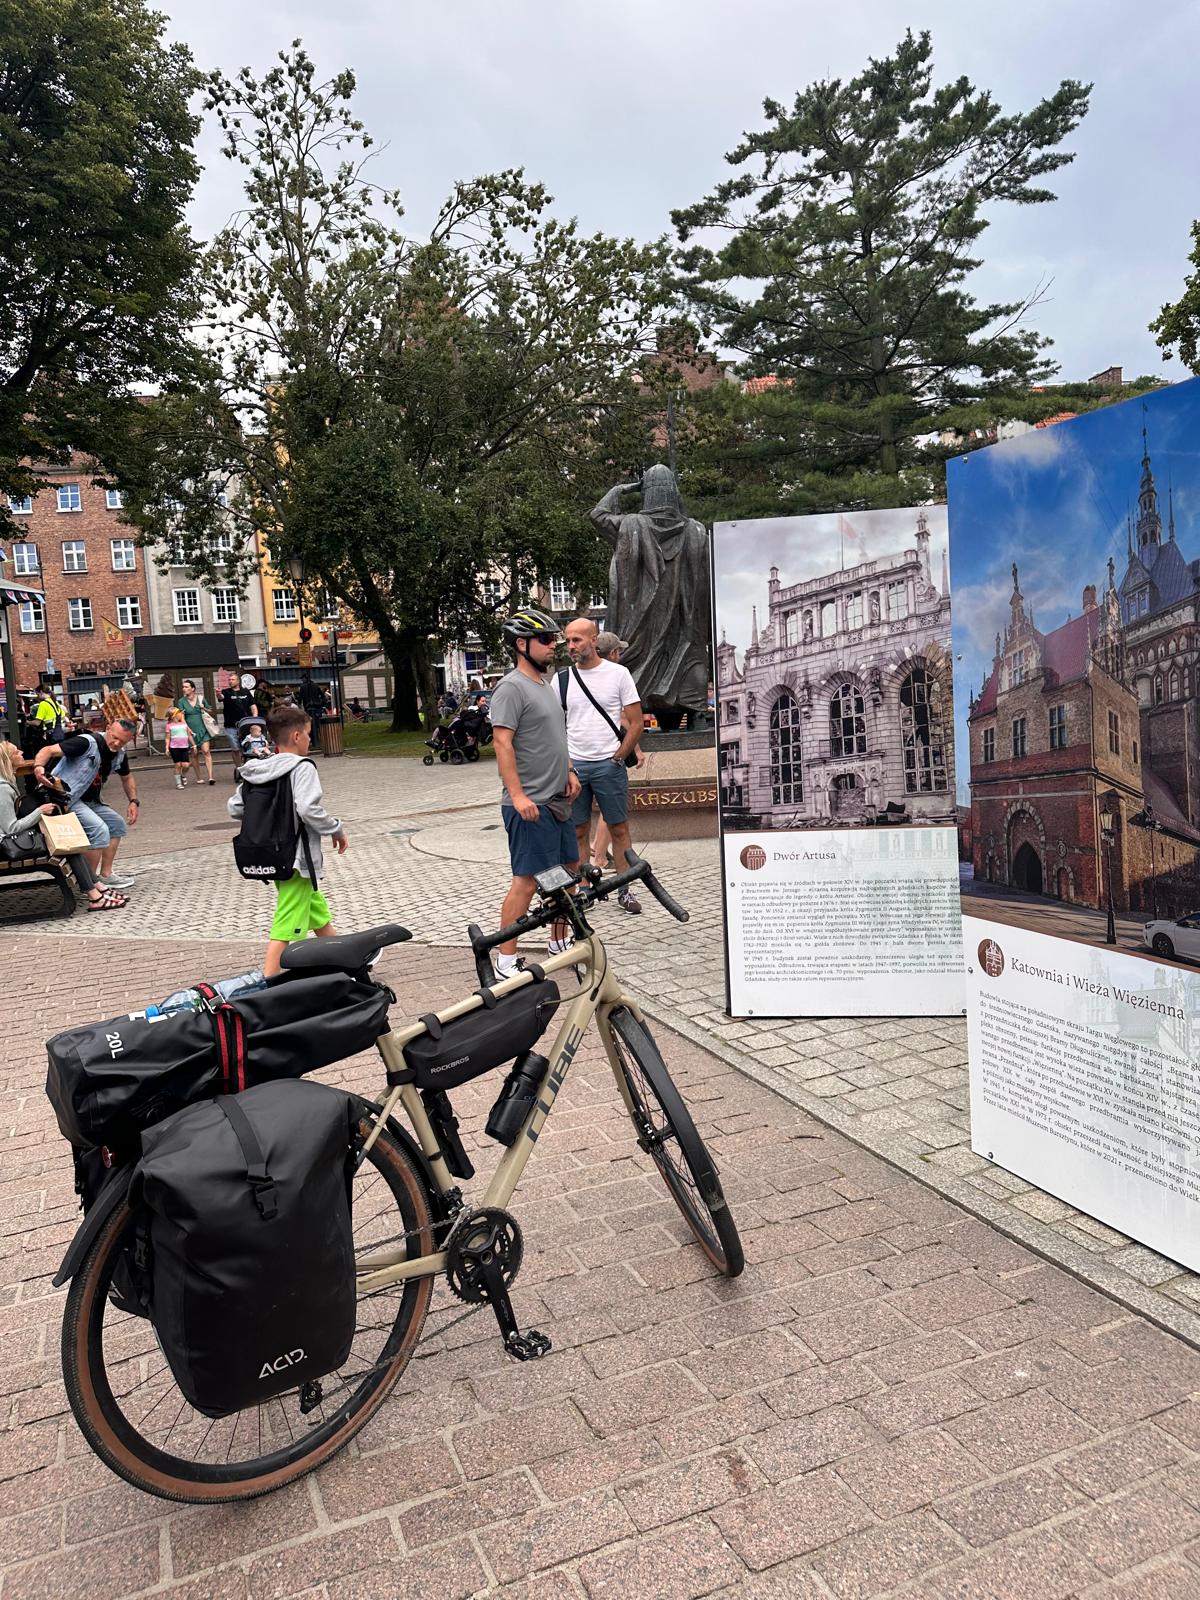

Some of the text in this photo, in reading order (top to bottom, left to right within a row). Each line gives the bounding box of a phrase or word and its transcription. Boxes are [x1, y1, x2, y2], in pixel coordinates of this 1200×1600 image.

[633, 789, 717, 806] KASZUBS
[773, 851, 836, 861] Dwór Artusa
[243, 865, 276, 875] adidas
[1011, 958, 1185, 1020] Katownia i Wieża Więzienna
[105, 1031, 124, 1060] 20L
[430, 1055, 470, 1075] ROCKBROS
